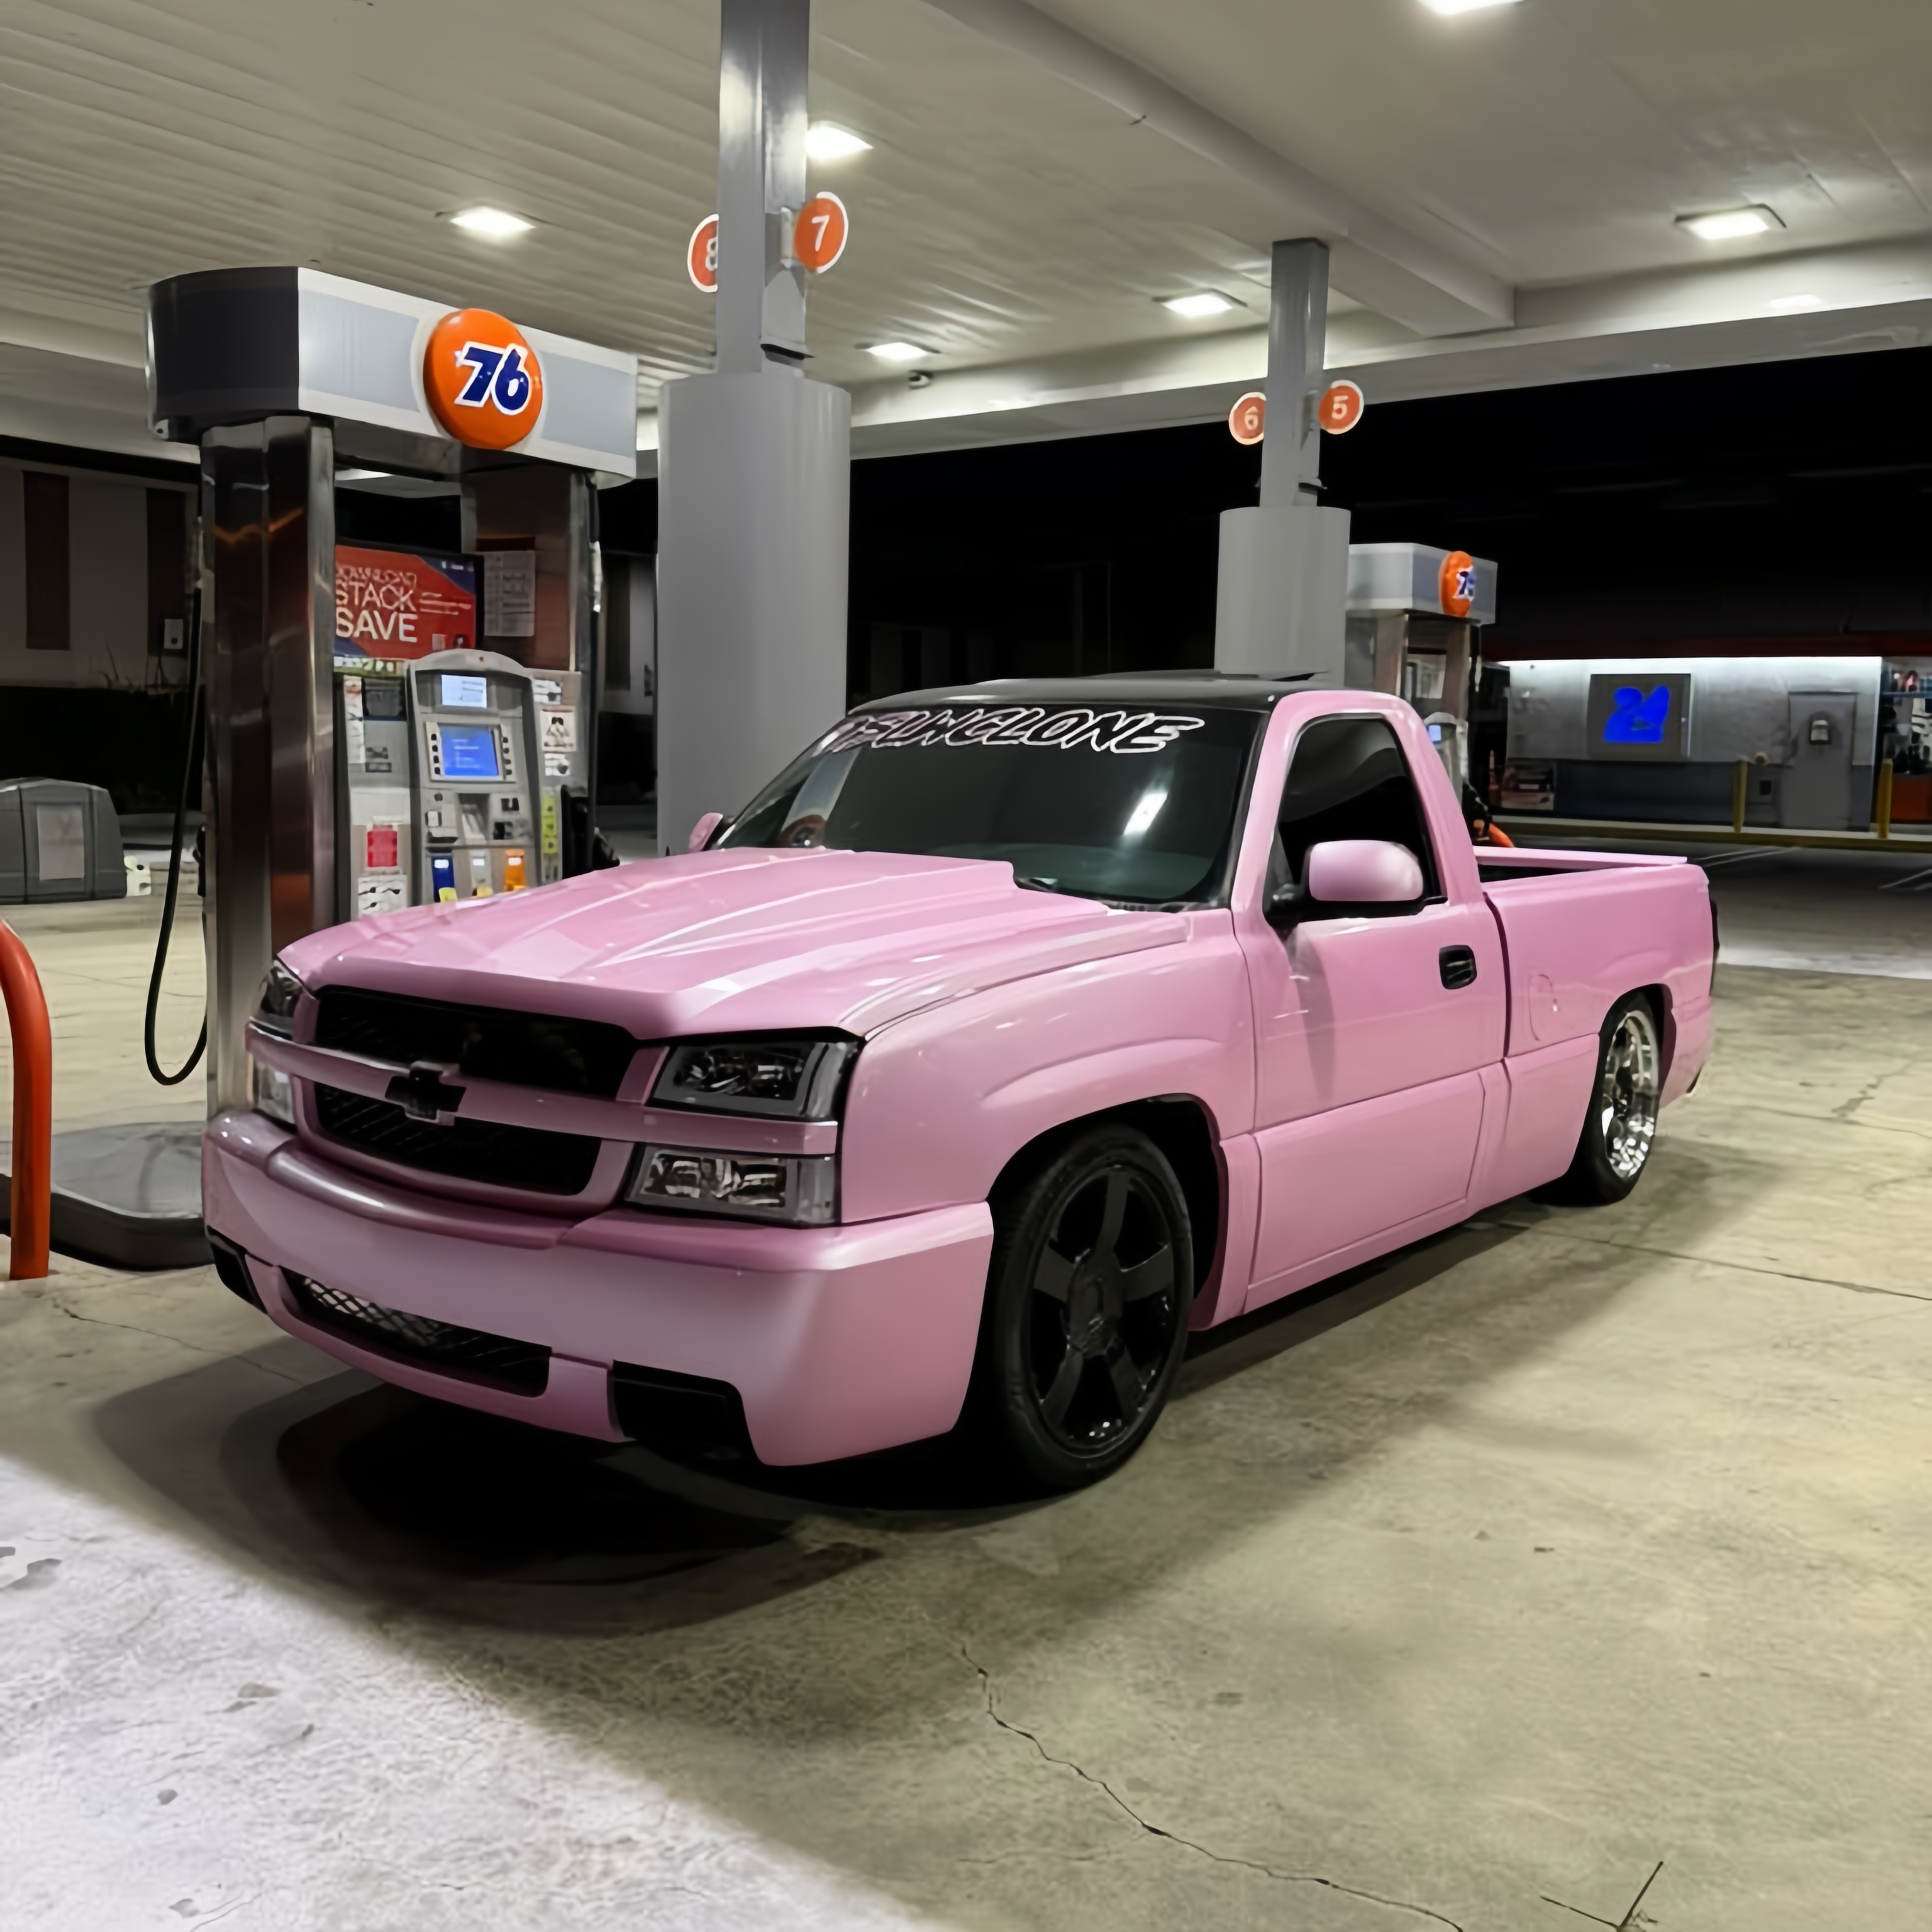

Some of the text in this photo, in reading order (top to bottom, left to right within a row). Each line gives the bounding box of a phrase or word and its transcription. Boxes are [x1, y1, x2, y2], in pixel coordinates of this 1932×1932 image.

[811, 214, 830, 252] 7
[454, 341, 532, 416] 76
[1245, 406, 1258, 430] 6
[1331, 395, 1348, 419] 5
[336, 582, 416, 612] STACK
[336, 607, 418, 643] SAVE
